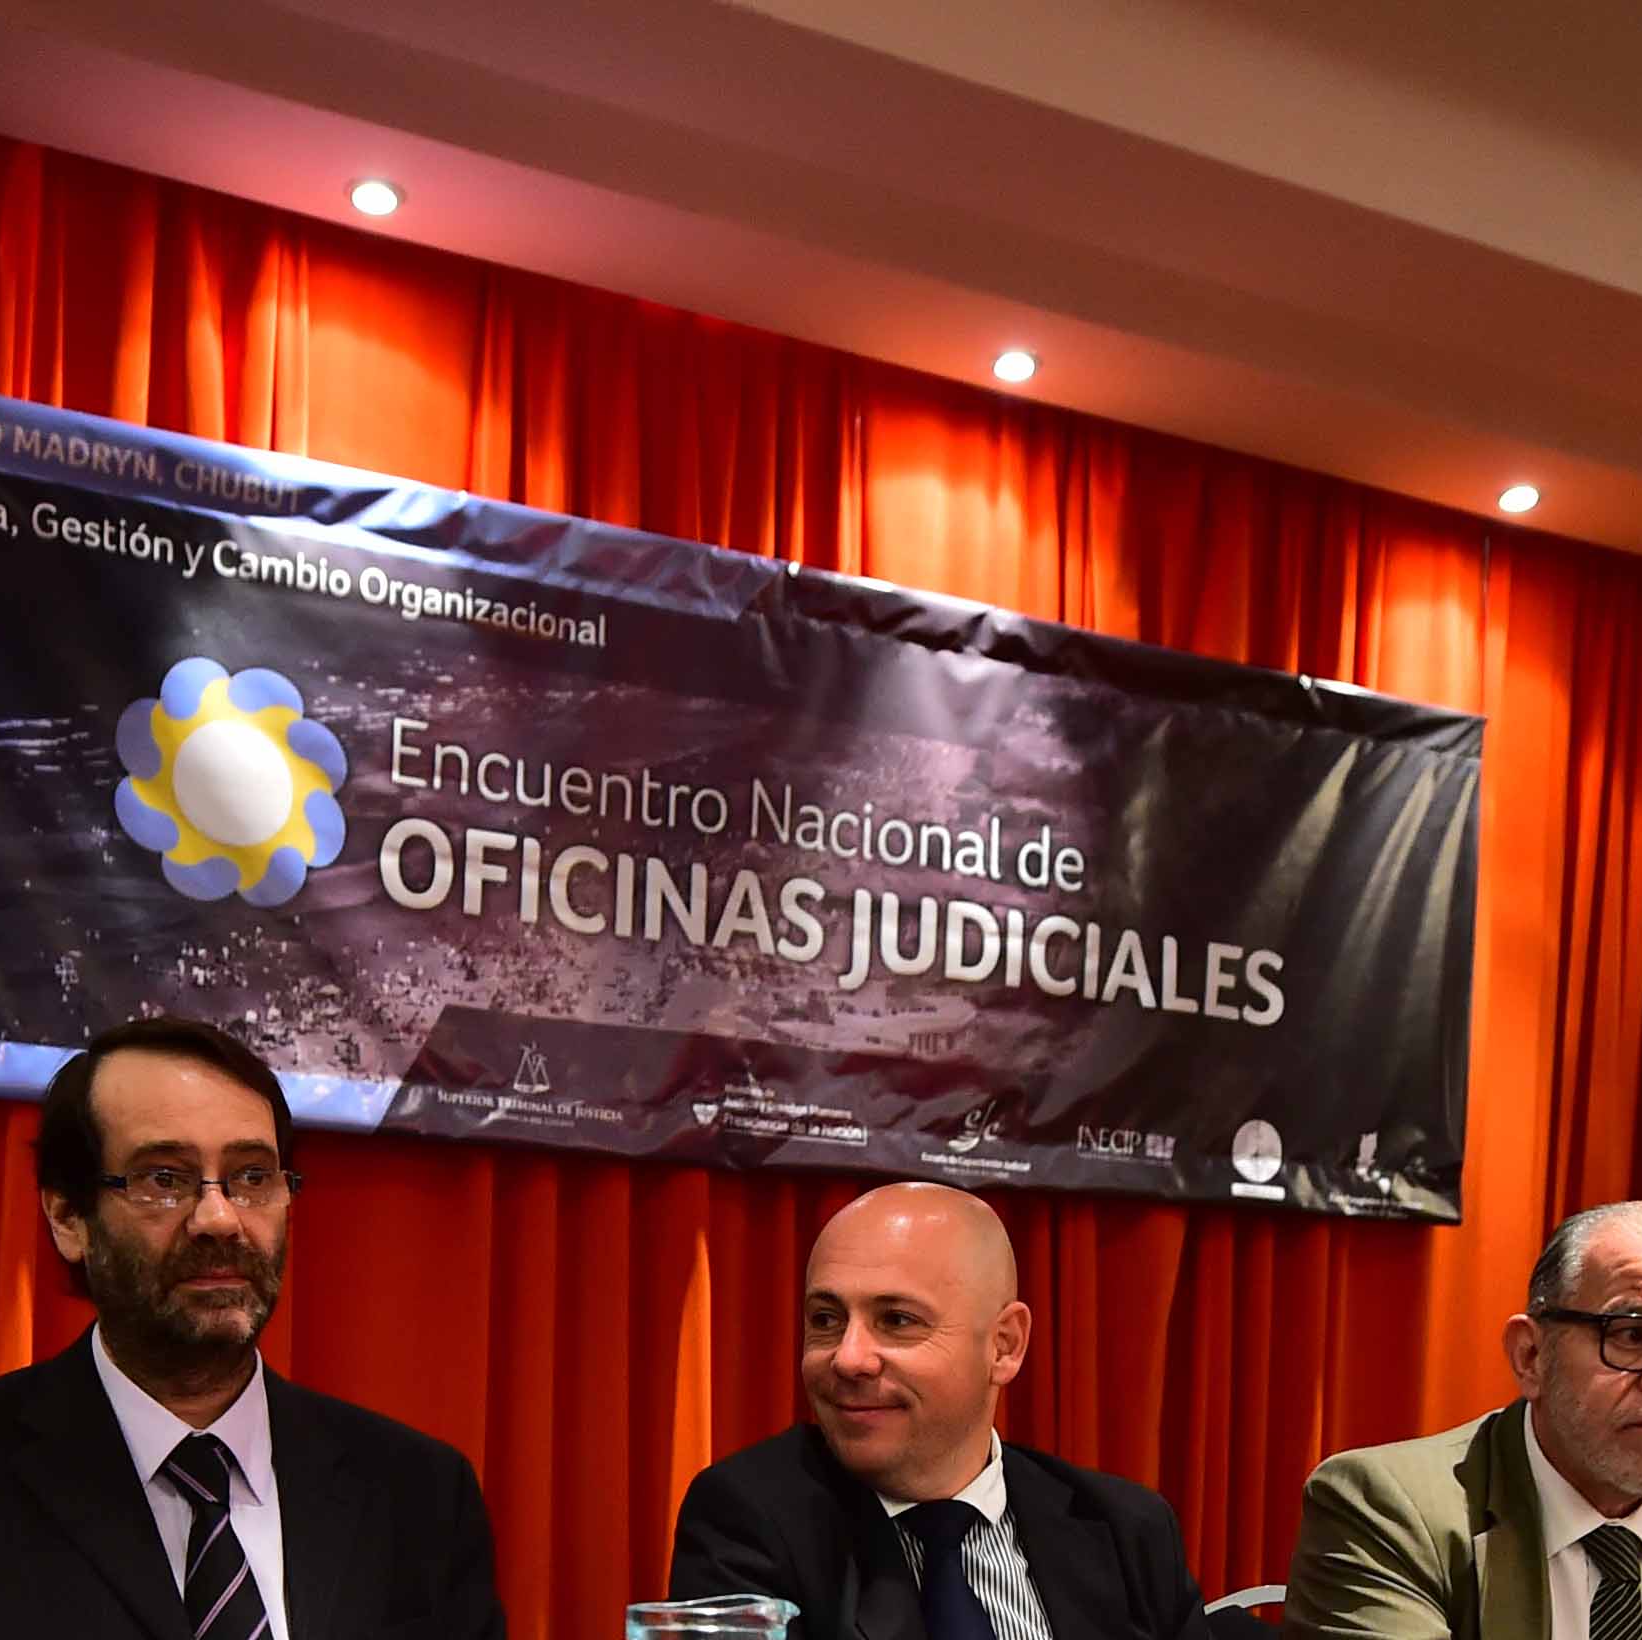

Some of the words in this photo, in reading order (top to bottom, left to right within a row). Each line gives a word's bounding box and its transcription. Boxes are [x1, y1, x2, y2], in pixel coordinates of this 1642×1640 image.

[173, 458, 300, 513] CHUBUT
[31, 502, 174, 565] Gestión
[183, 542, 205, 576] y
[212, 540, 352, 597] Cambio
[358, 567, 607, 647] Organizacional
[390, 717, 728, 834] Encuentro
[750, 777, 1002, 881] Nacional
[1017, 824, 1086, 893] de
[377, 818, 827, 963] OFICINAS
[837, 887, 1286, 1026] JUDICIALES
